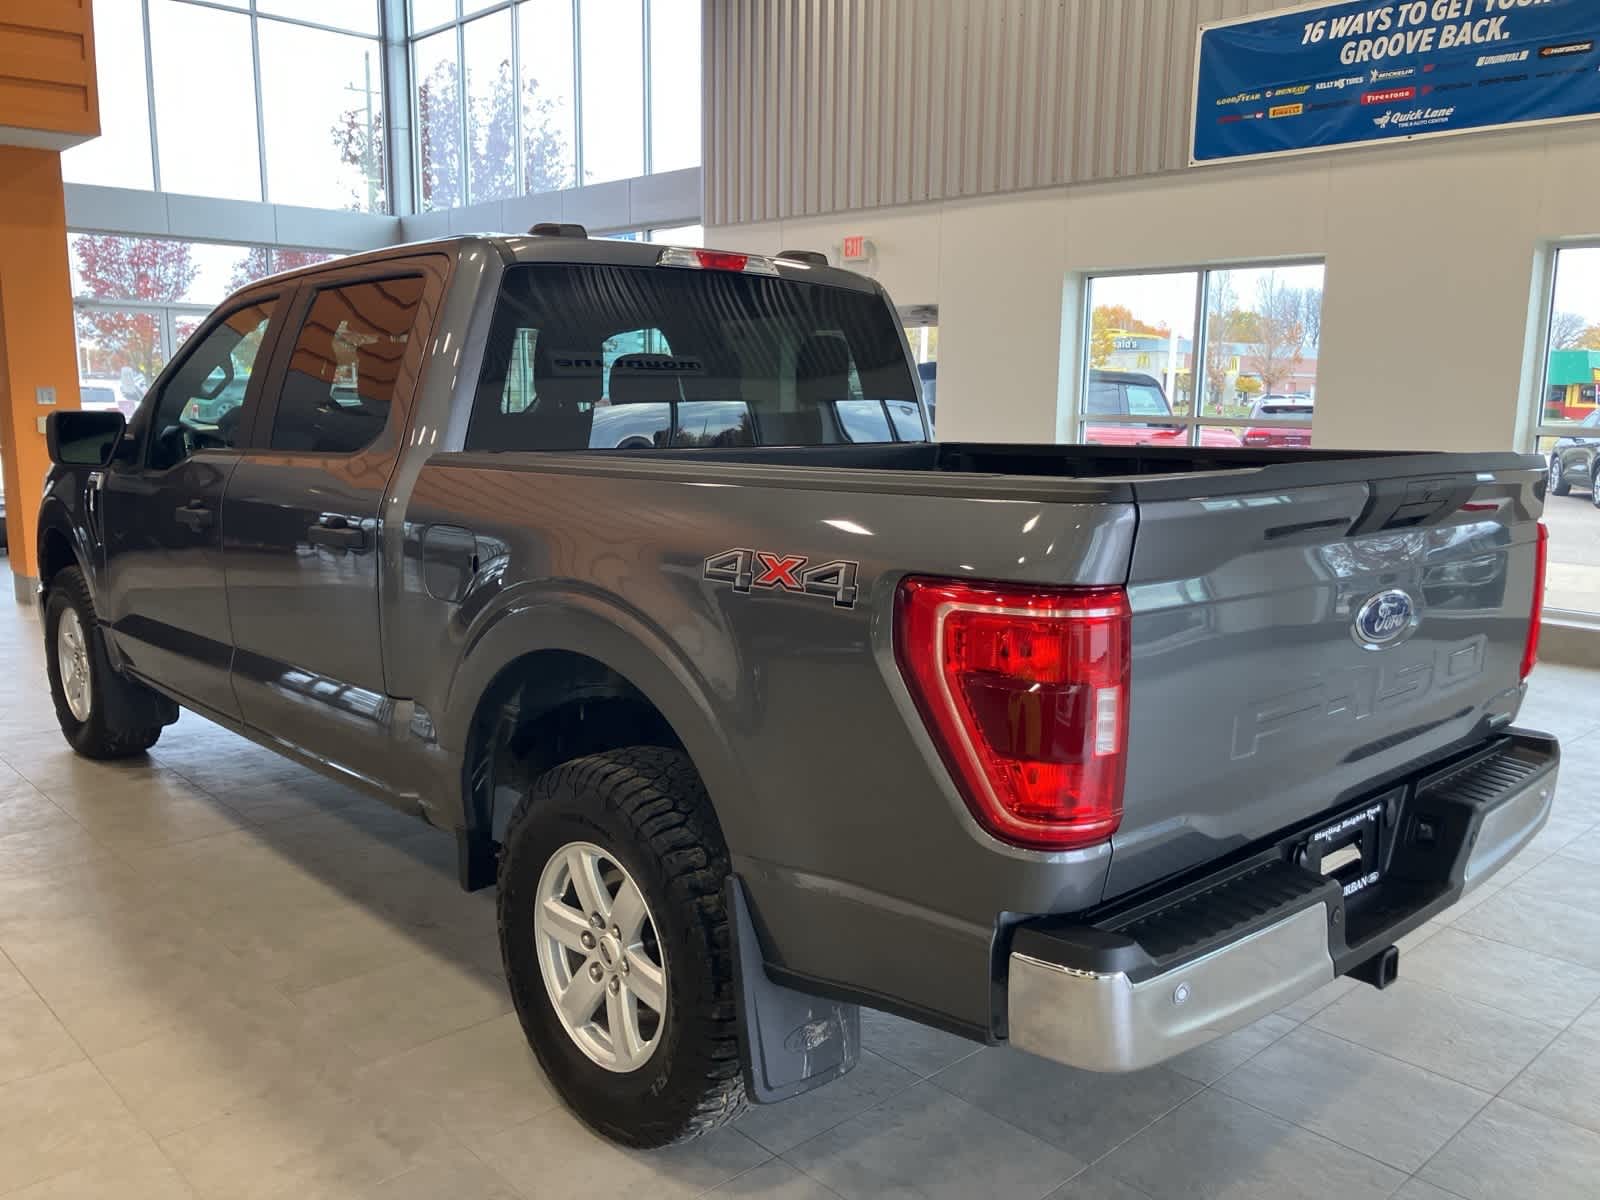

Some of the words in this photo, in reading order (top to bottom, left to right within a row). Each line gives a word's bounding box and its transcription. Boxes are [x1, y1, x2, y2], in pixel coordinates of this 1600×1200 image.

[1301, 20, 1327, 45] 16
[1329, 7, 1393, 40] WAYS
[1397, 1, 1427, 28] TO
[1431, 0, 1475, 21] GET
[1340, 27, 1436, 65] GROOVE
[1438, 16, 1511, 49] BACK.
[1216, 93, 1261, 106] GOODYEAR
[1391, 109, 1423, 124] Quick
[1424, 107, 1454, 119] Lane
[843, 237, 864, 258] EXIT
[1374, 602, 1411, 633] Ford
